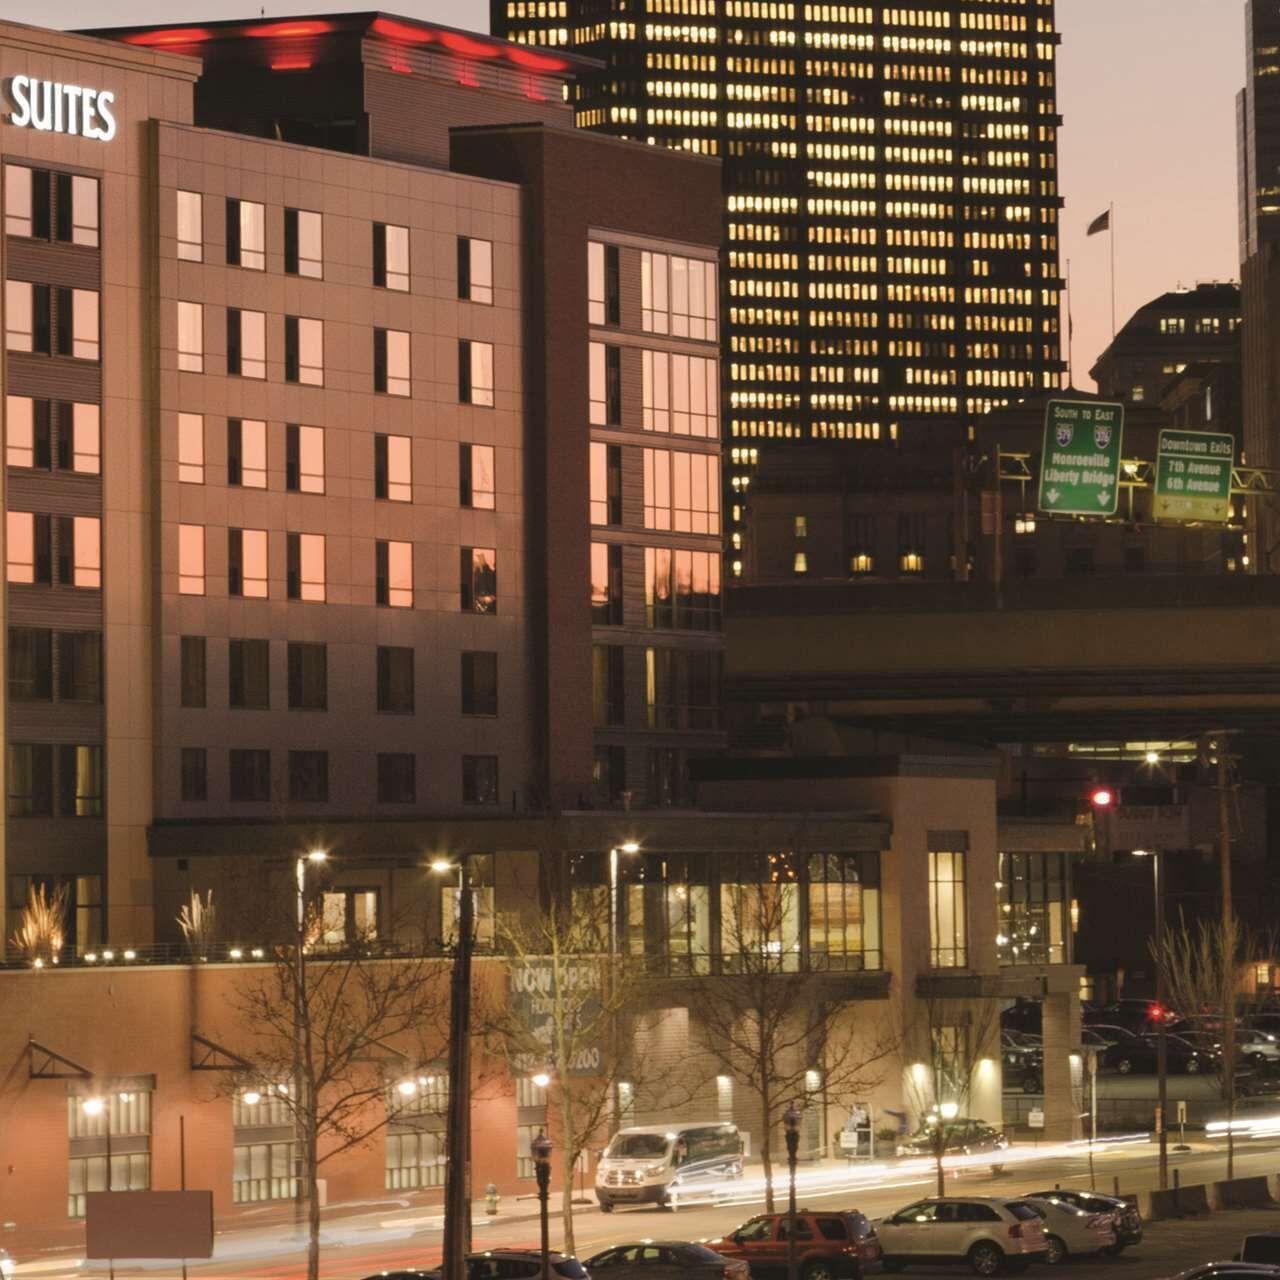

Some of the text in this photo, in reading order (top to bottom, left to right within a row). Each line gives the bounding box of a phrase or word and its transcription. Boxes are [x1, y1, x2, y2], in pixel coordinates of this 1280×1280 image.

[8, 75, 117, 142] SUITES
[1161, 437, 1232, 455] Downtown Exits
[1051, 452, 1110, 467] Monroeville
[1168, 460, 1222, 476] 7th Avenue
[1044, 469, 1115, 487] Liberty Bridge
[1166, 477, 1221, 492] 6th Avenue
[510, 967, 552, 992] NOW
